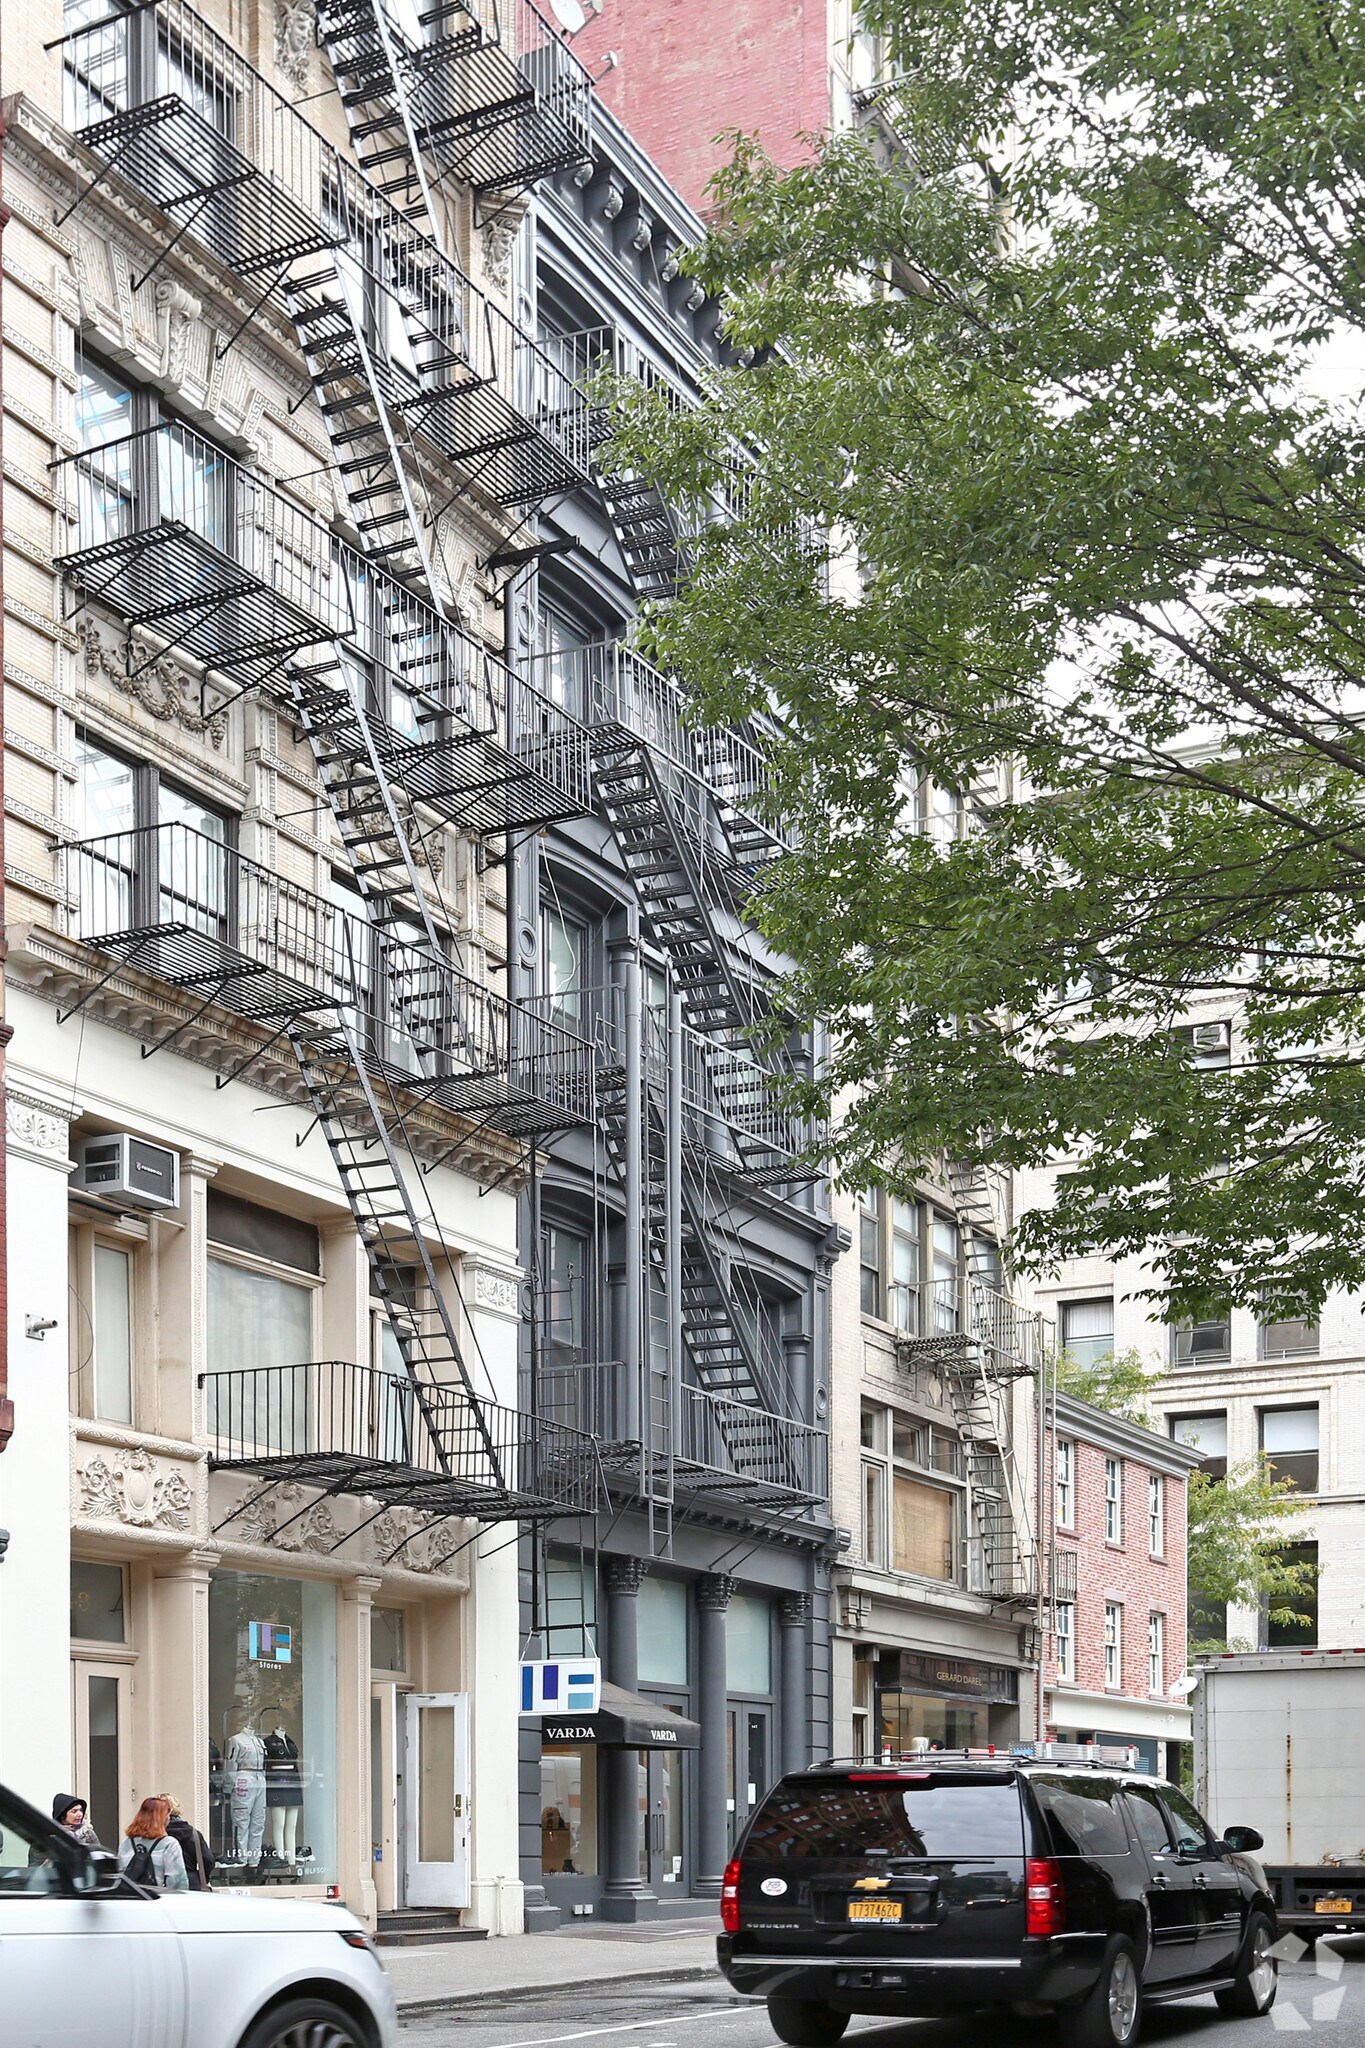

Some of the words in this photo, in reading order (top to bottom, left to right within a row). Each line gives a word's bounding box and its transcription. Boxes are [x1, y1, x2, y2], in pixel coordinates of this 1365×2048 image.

[259, 1661, 282, 1670] Stores
[936, 1671, 963, 1683] GERARD
[963, 1675, 983, 1687] DAREL
[546, 1727, 596, 1739] VARDA
[650, 1729, 678, 1742] VARDA
[852, 1903, 899, 1918] T737462C
